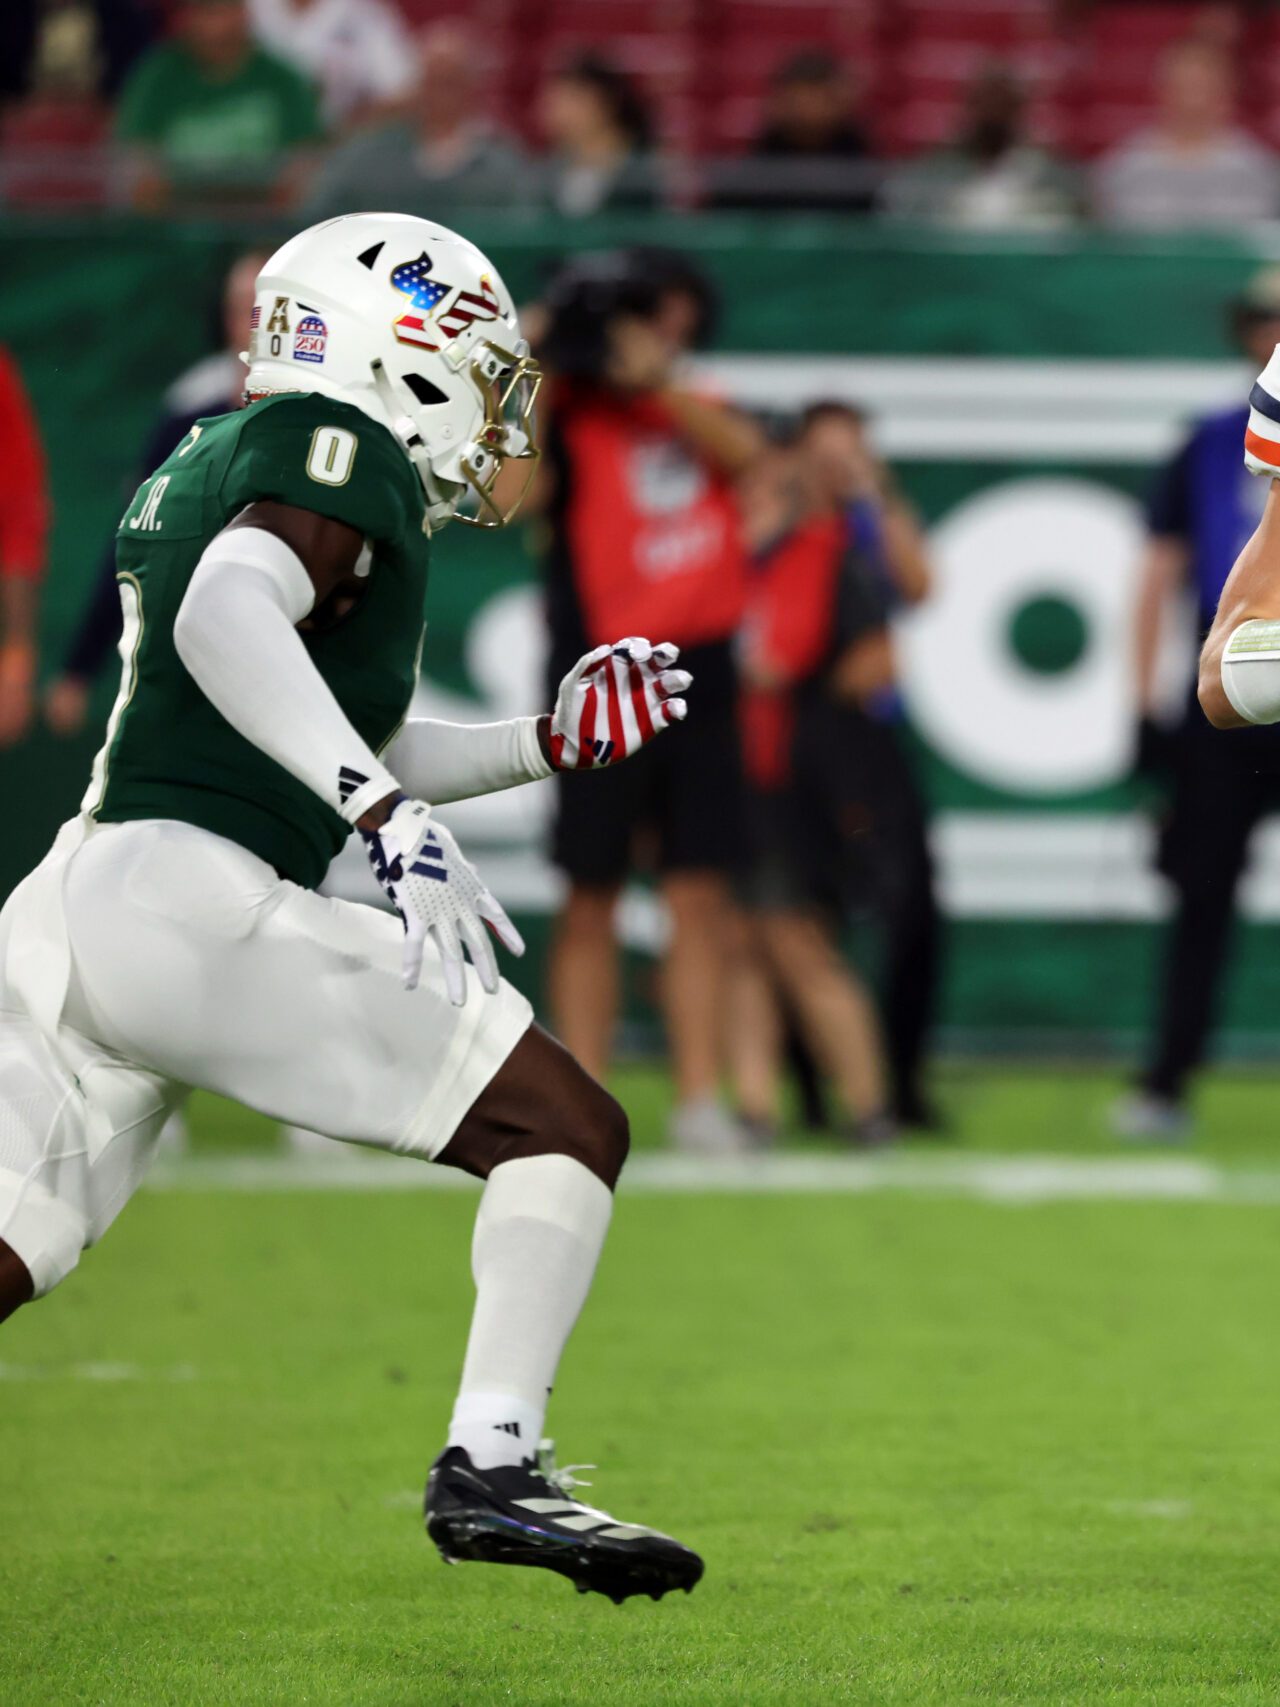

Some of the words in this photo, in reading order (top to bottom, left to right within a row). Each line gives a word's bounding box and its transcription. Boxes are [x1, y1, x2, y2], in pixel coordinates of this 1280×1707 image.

[295, 335, 325, 352] 250
[305, 424, 359, 487] 0
[129, 475, 162, 531] JR.
